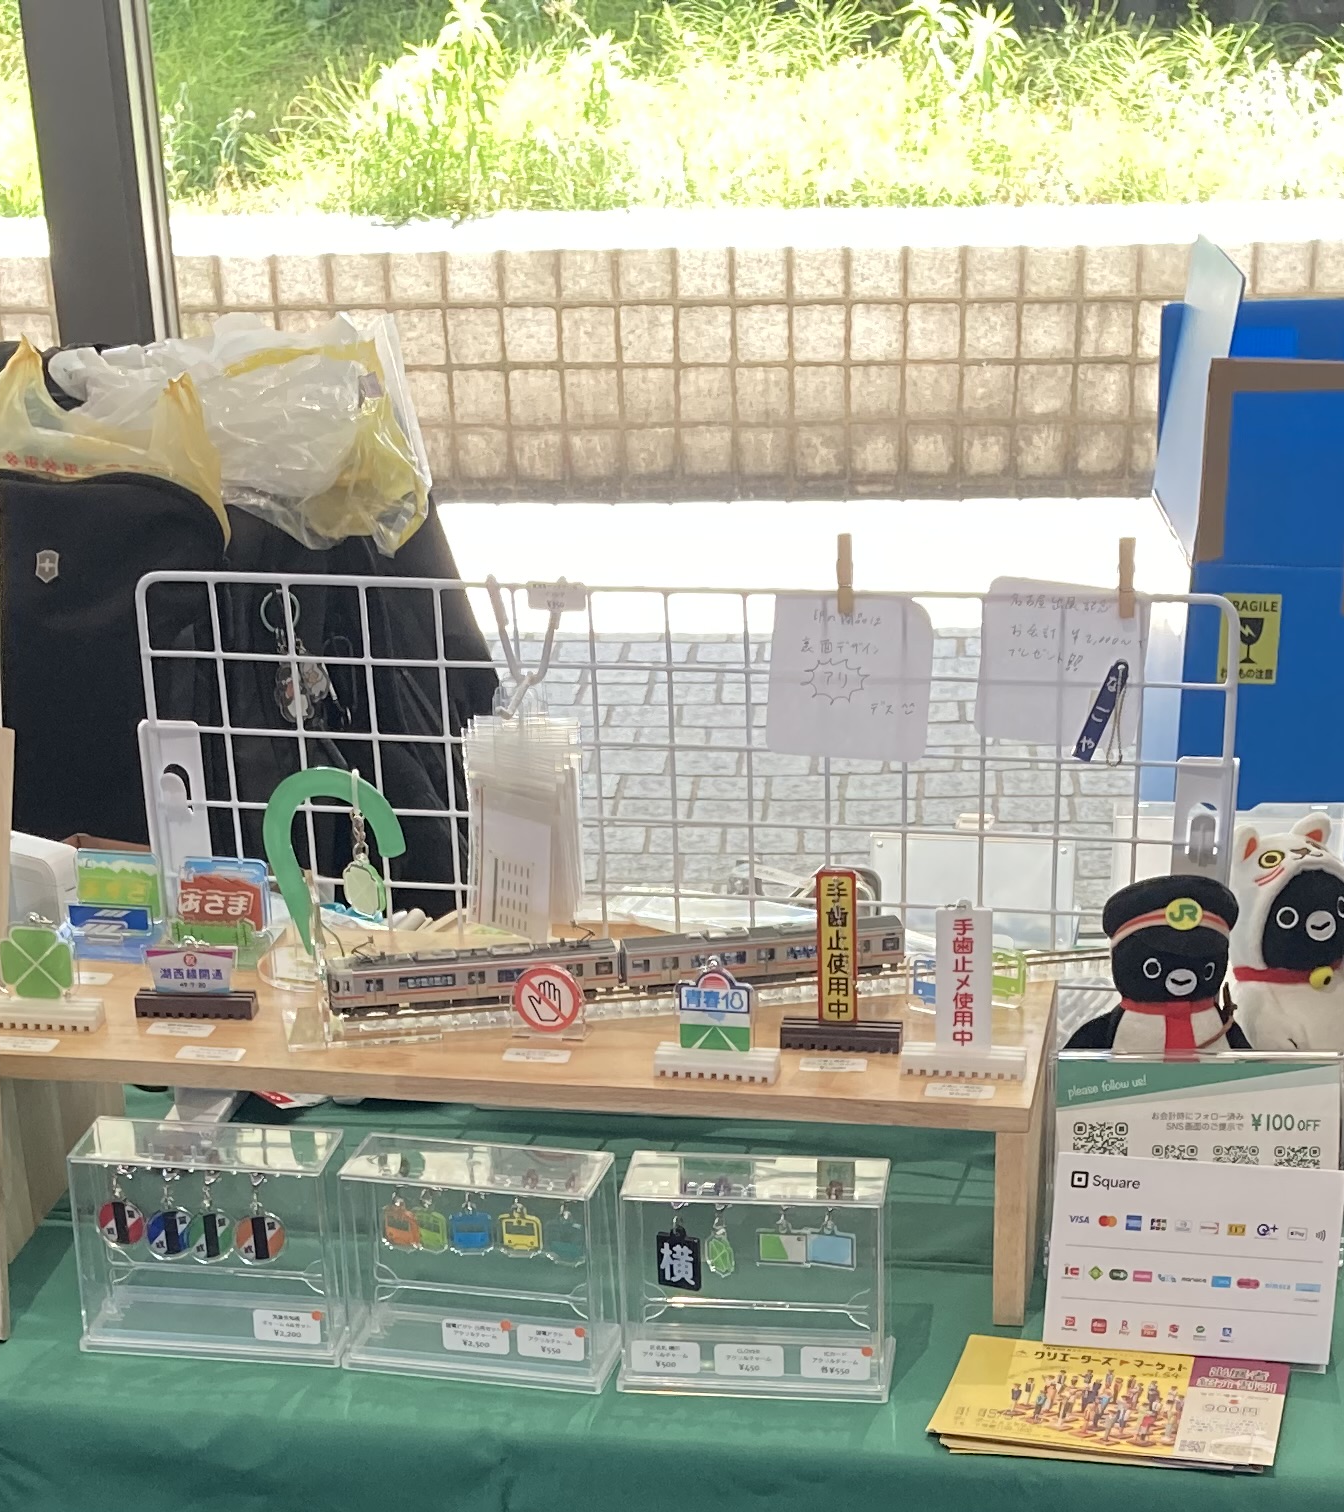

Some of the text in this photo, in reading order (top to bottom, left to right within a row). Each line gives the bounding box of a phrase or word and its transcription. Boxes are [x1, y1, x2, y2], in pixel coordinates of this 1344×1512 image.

[1232, 600, 1278, 612] RAGILE
[823, 671, 848, 689] アリ
[1220, 668, 1273, 680] わもの注意
[179, 892, 250, 915] あさま
[1168, 904, 1198, 923] JR
[825, 881, 849, 1020] 手歯止使用中
[159, 967, 224, 981] 湖西線開通
[952, 918, 975, 1047] 手歯止メ使用中
[1067, 1074, 1147, 1100] please follow us!
[1250, 1113, 1321, 1132] ¥100 OFF
[1092, 1174, 1141, 1190] Square
[1068, 1214, 1090, 1224] VISA
[660, 1242, 696, 1286] 横
[462, 1339, 490, 1348] ¥2,500
[540, 1345, 561, 1354] ¥550
[655, 1360, 677, 1368] ¥500
[1034, 1350, 1188, 1372] クリエーターズ マーケット
